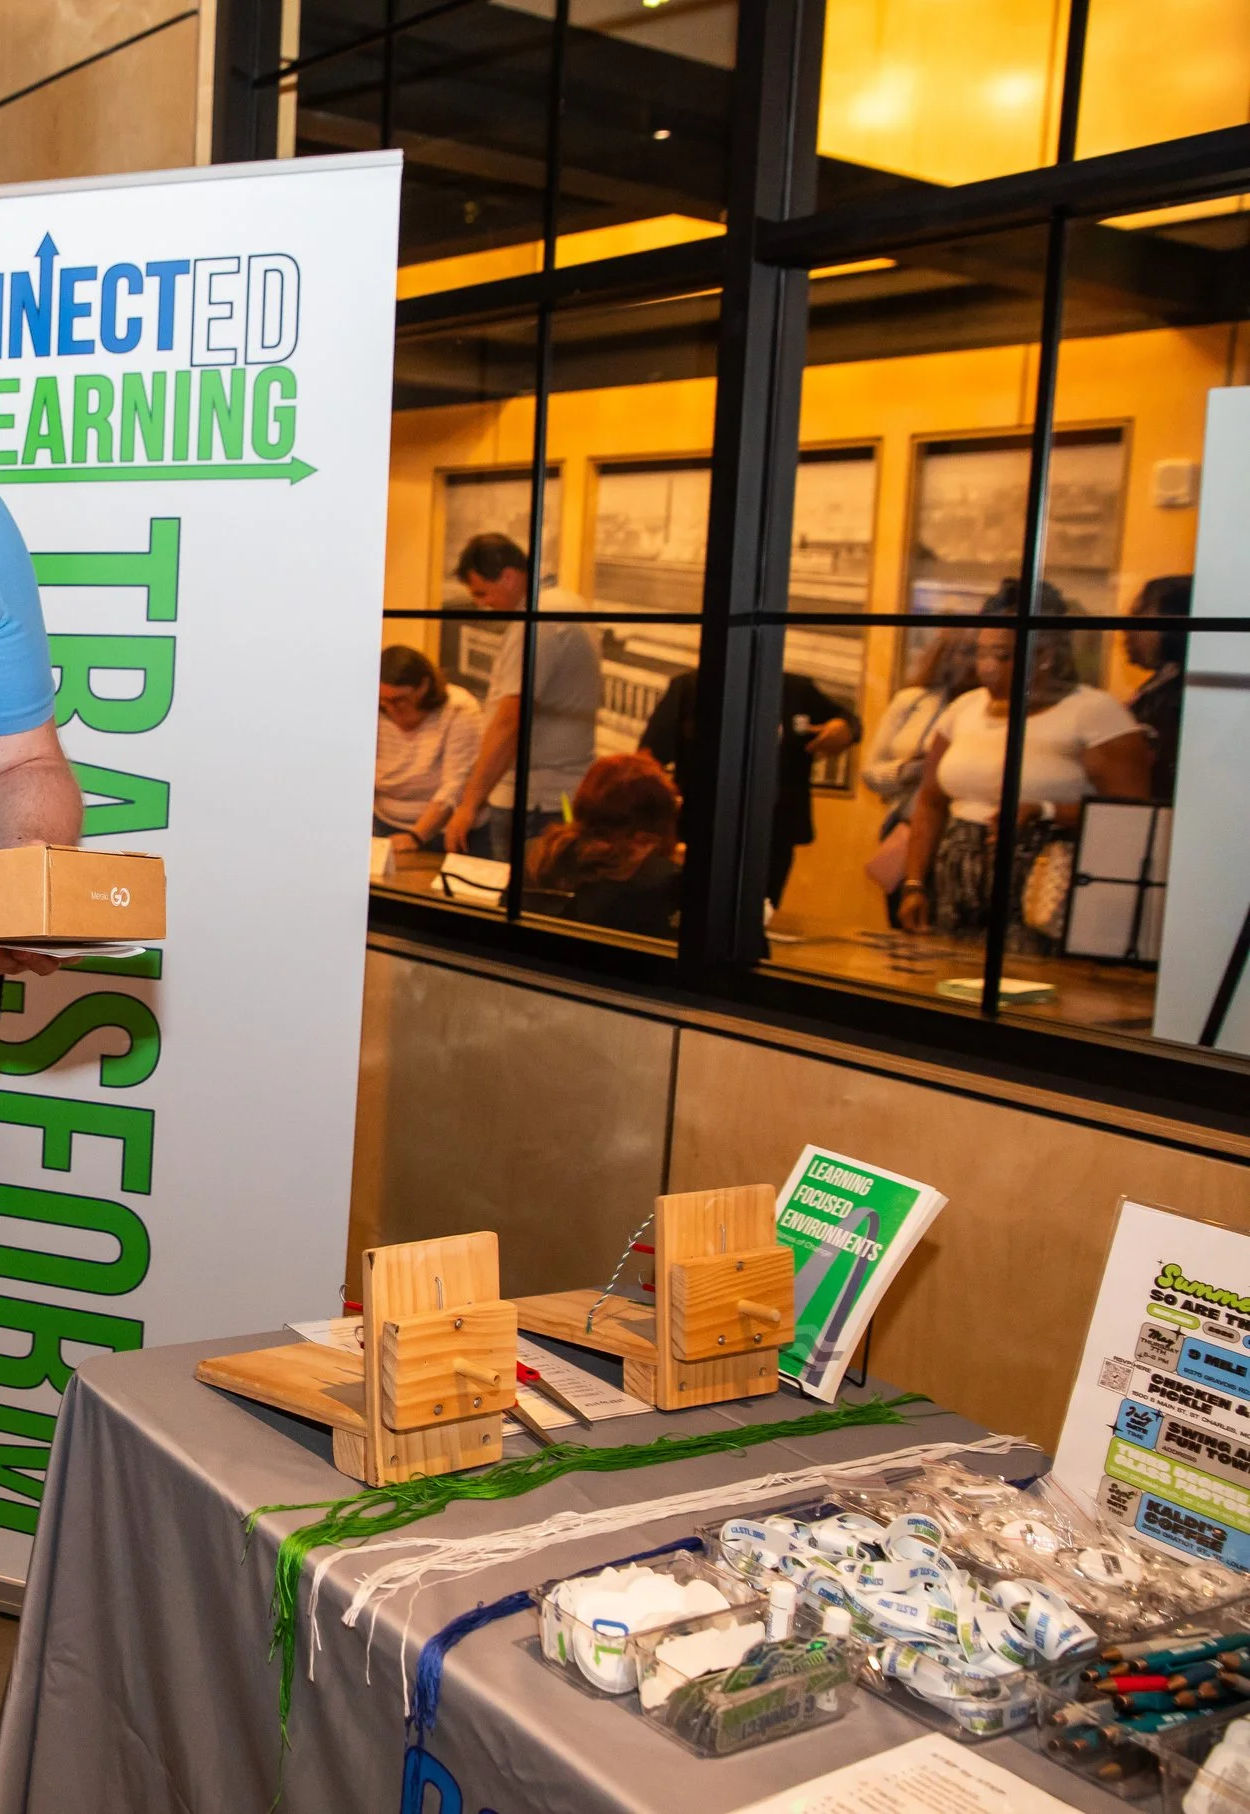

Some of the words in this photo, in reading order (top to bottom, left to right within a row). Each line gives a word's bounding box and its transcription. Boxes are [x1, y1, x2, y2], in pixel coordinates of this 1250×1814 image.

[110, 886, 131, 907] GO
[806, 1159, 875, 1197] LEARNING
[793, 1184, 854, 1219] FOCUSED
[779, 1208, 884, 1262] ENVIRONMENTS
[1150, 1289, 1178, 1306] SO
[1180, 1299, 1221, 1321] ARE
[1140, 1337, 1179, 1354] THURSDAY
[1148, 1328, 1175, 1347] May
[1150, 1346, 1167, 1356] 7TH
[1113, 1355, 1133, 1368] RSVP
[1133, 1363, 1152, 1374] HERE
[1187, 1348, 1202, 1361] 9
[1203, 1353, 1248, 1378] MILE
[1203, 1374, 1237, 1391] GRAVOIS
[1147, 1384, 1214, 1416] PICKLE
[1151, 1373, 1233, 1411] CHICKEN
[1235, 1403, 1250, 1419] &
[1156, 1400, 1175, 1411] MAIN
[1125, 1406, 1153, 1424] July
[1127, 1429, 1144, 1441] TIME
[1164, 1432, 1202, 1455] FUN
[1167, 1421, 1232, 1455] SWING
[1161, 1445, 1198, 1463] ADDRESS
[1108, 1506, 1124, 1519] TIME
[1146, 1499, 1228, 1543] KALDI'S
[1144, 1510, 1225, 1554] COFFEE
[1162, 1530, 1195, 1548] GRATIOT
